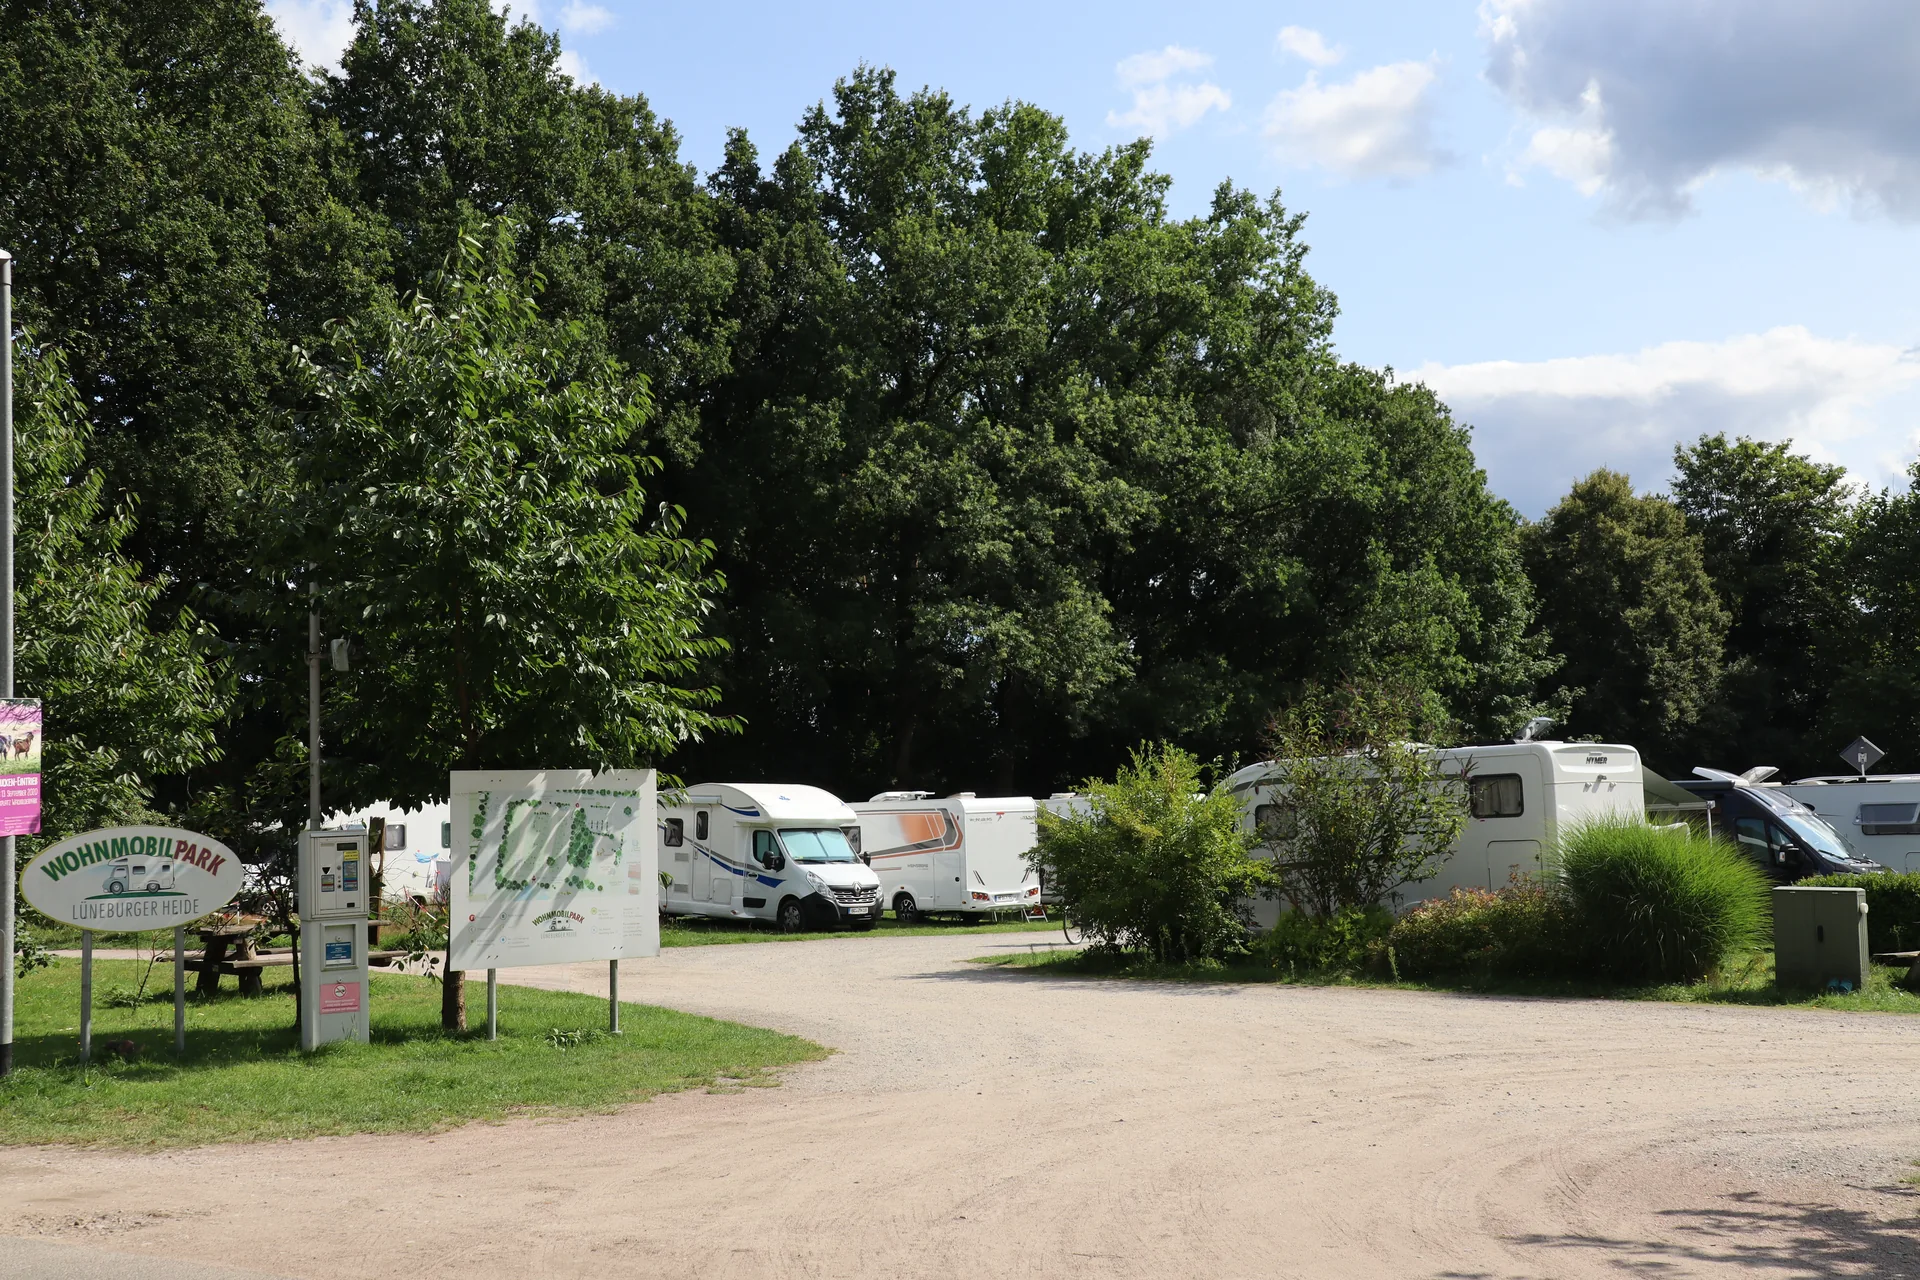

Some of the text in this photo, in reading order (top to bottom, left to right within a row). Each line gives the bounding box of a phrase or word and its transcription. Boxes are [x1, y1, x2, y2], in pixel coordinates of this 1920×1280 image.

[40, 836, 226, 882] WOHNMOBILPARK
[72, 899, 200, 920] LÜNEBURGER HEIDE
[532, 910, 585, 926] WOHNMOBILPARK
